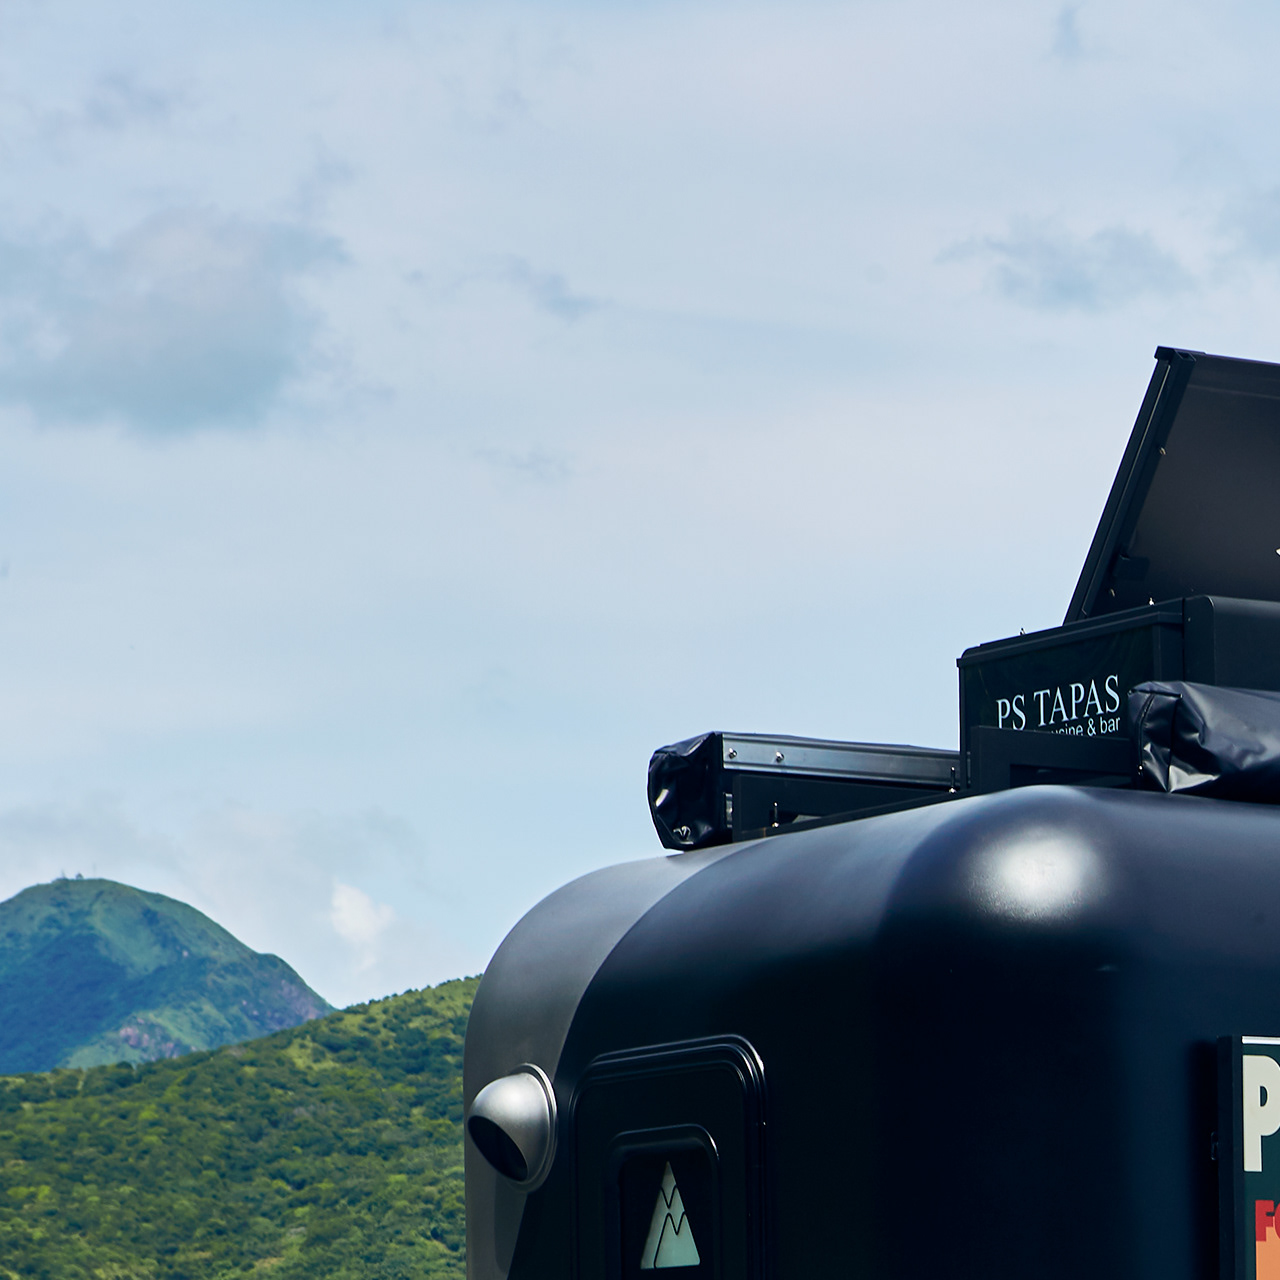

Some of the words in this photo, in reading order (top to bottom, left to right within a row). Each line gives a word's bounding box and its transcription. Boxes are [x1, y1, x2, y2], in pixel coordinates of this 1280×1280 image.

[996, 694, 1027, 731] PS
[1033, 674, 1121, 728] TAPAS
[1086, 717, 1097, 737] &
[1099, 716, 1121, 734] bar
